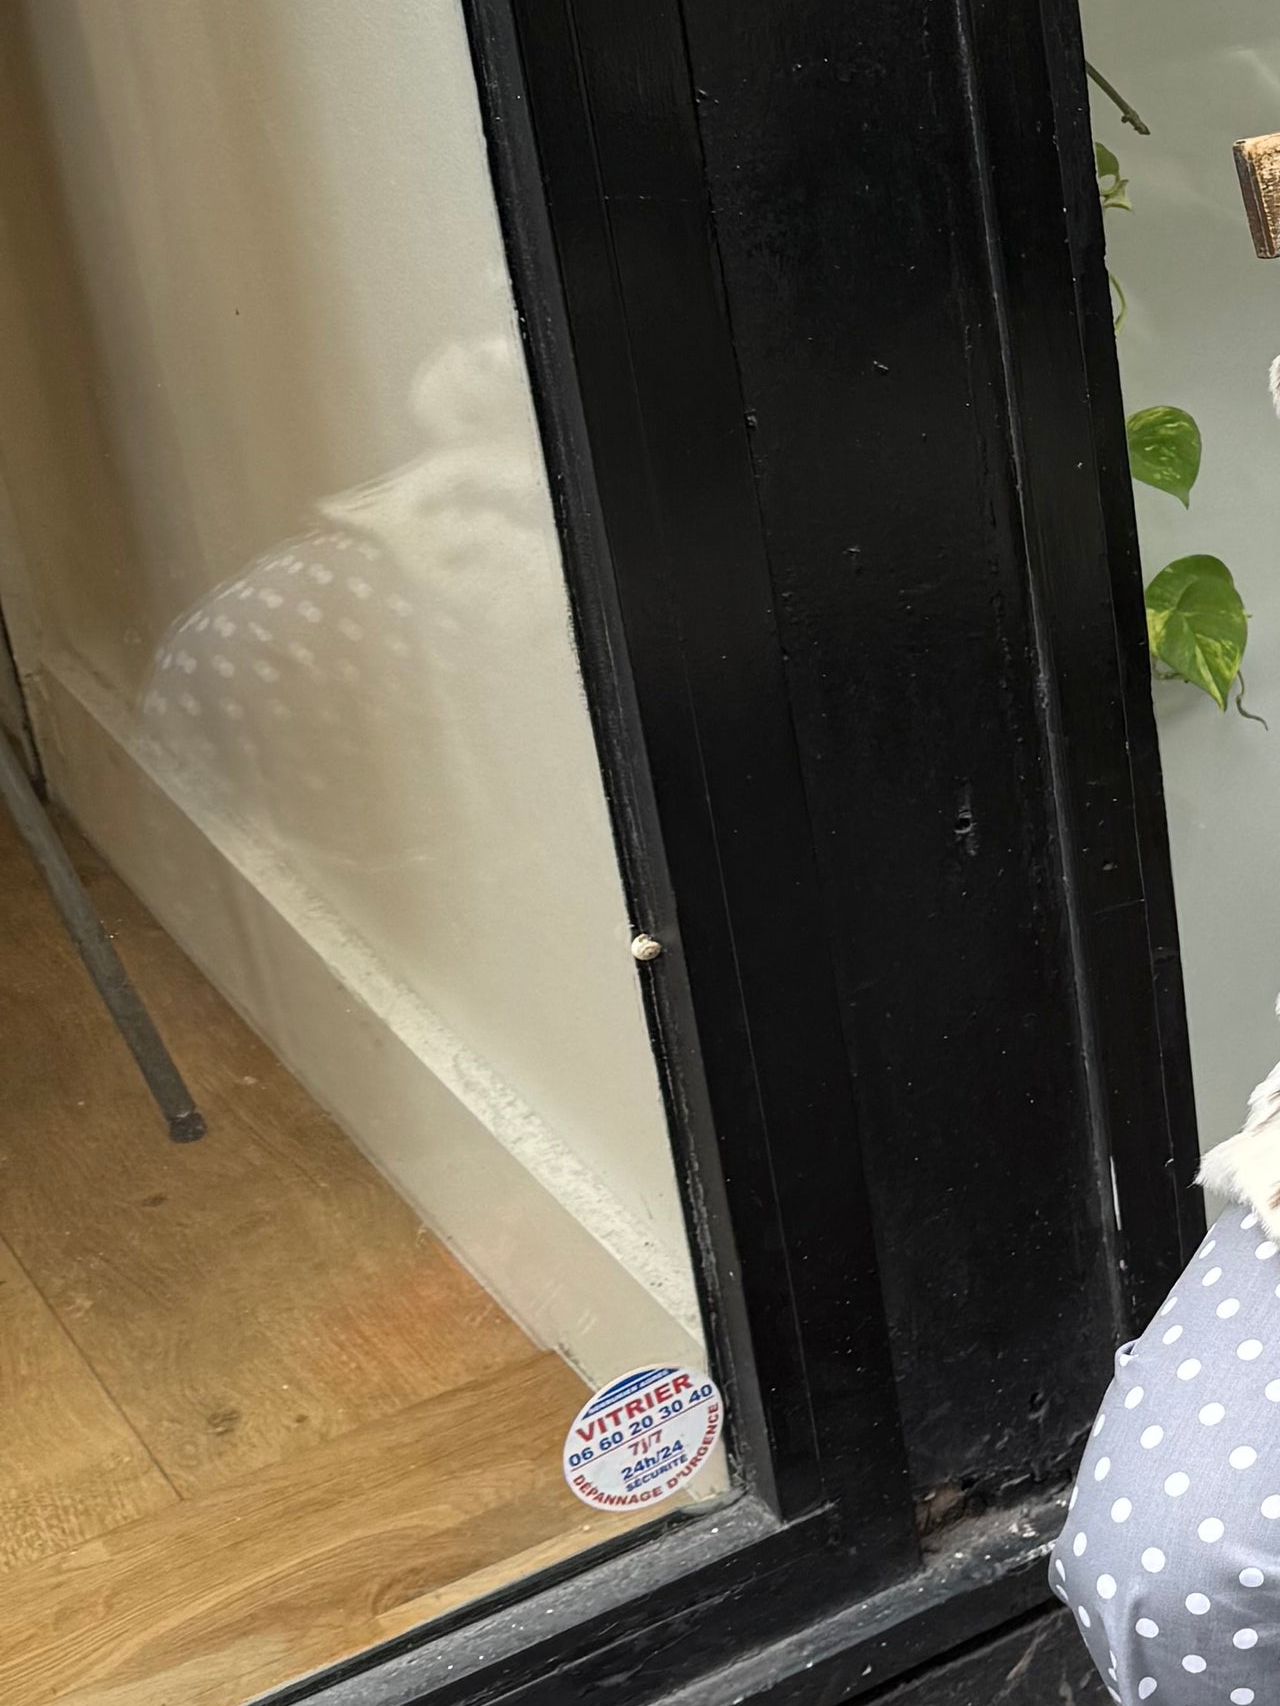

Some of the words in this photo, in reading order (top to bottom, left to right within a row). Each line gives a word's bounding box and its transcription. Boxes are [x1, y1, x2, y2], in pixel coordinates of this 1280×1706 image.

[569, 1447, 594, 1467] 06
[599, 1431, 624, 1451] 60
[628, 1415, 653, 1436] 20
[658, 1399, 683, 1420] 30
[688, 1384, 713, 1404] 40
[575, 1373, 694, 1443] VITRIER
[621, 1439, 684, 1480] 24h/24
[627, 1429, 663, 1456] 7j/7
[572, 1474, 664, 1506] DÉPANNAGE
